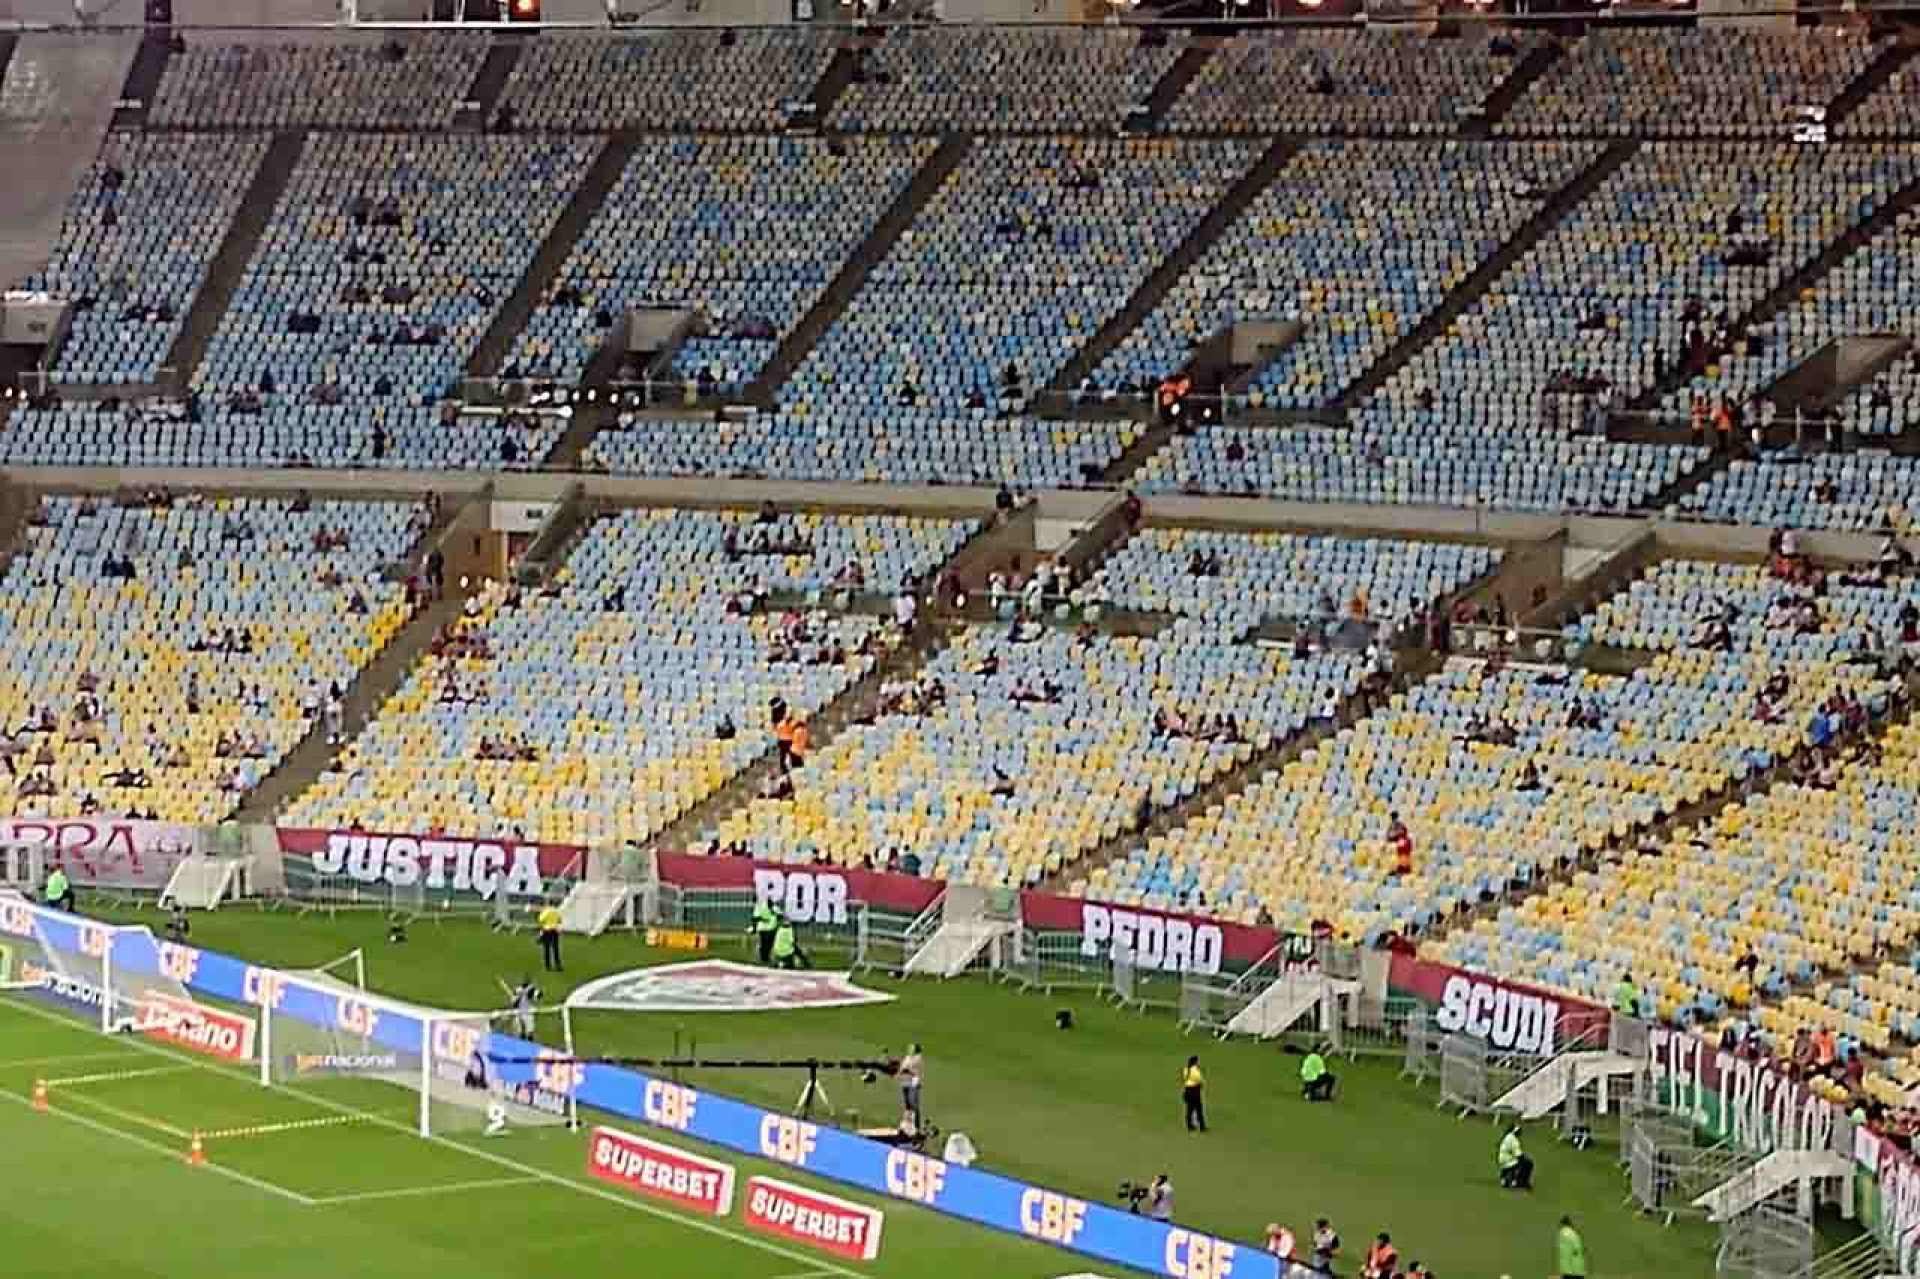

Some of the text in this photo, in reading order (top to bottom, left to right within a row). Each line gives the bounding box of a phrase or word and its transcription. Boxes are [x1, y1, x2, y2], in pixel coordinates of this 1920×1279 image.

[312, 833, 542, 900] JUSTIÇA
[753, 869, 847, 924] POR
[158, 939, 198, 983] CBF
[1081, 903, 1224, 974] PEDRO
[1437, 974, 1560, 1056] SCUDI
[645, 1079, 697, 1130] CBF
[1650, 1028, 1707, 1127] FIEL
[759, 1112, 817, 1166] CBF
[595, 1138, 722, 1201] SUPERBET
[886, 1149, 946, 1203] CBF
[750, 1188, 867, 1245] SUPERBET
[1020, 1187, 1088, 1245] CBF
[1165, 1227, 1236, 1279] CBF
